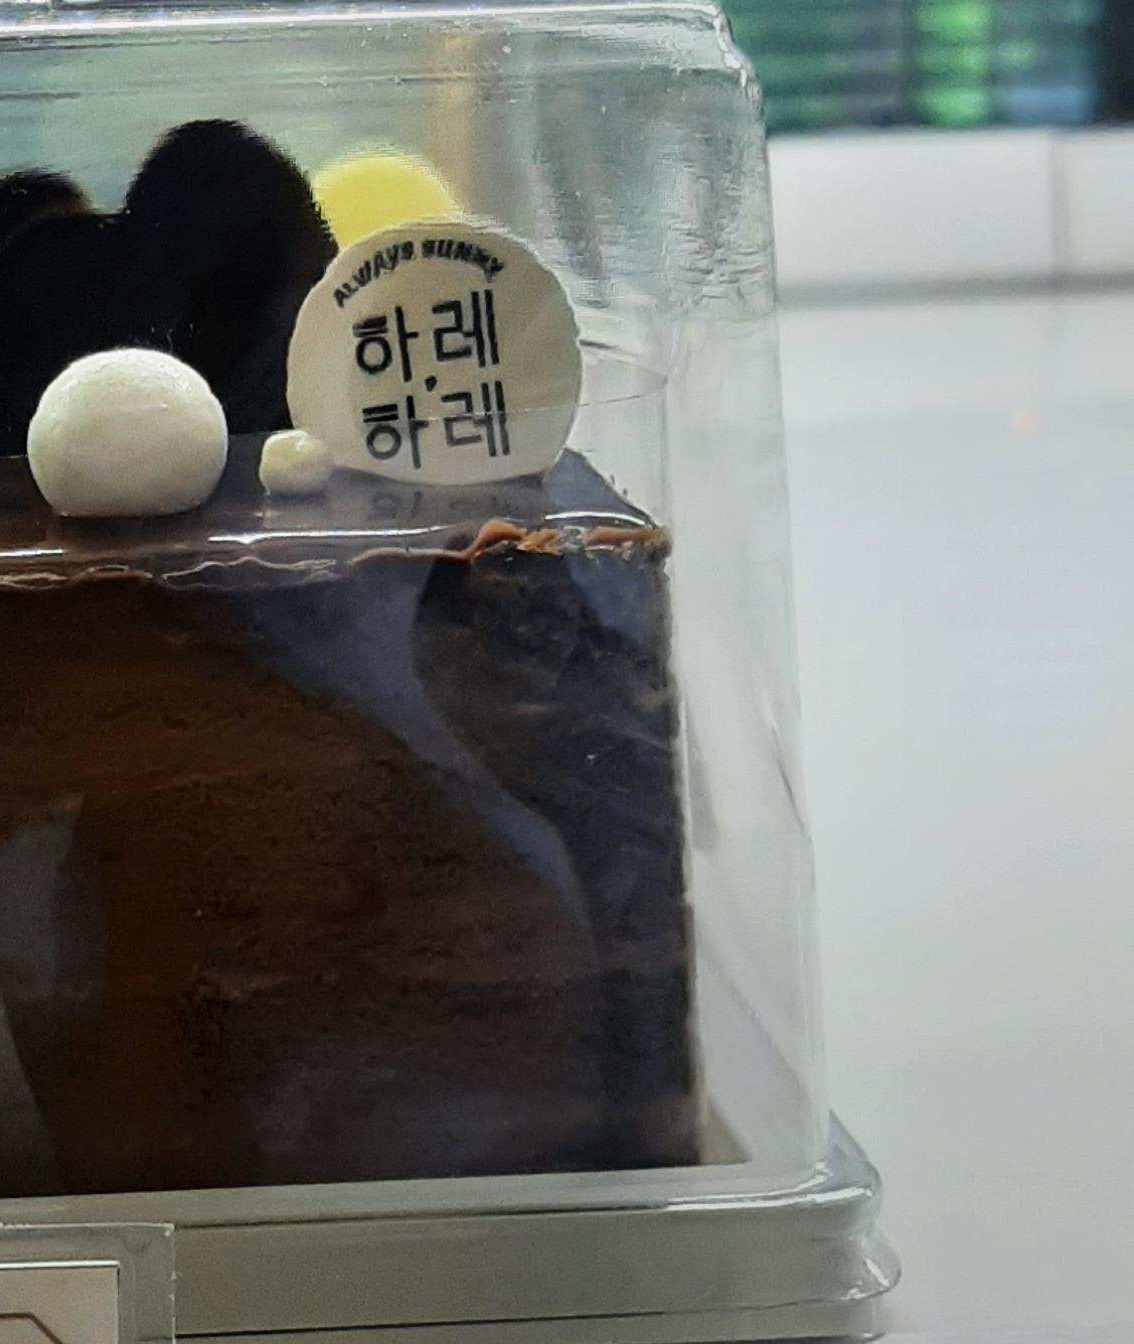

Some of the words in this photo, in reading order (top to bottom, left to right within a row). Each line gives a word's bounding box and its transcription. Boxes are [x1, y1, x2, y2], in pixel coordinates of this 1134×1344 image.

[332, 241, 415, 308] ALWAYS
[352, 289, 500, 383] 하레
[362, 381, 510, 470] 하레
